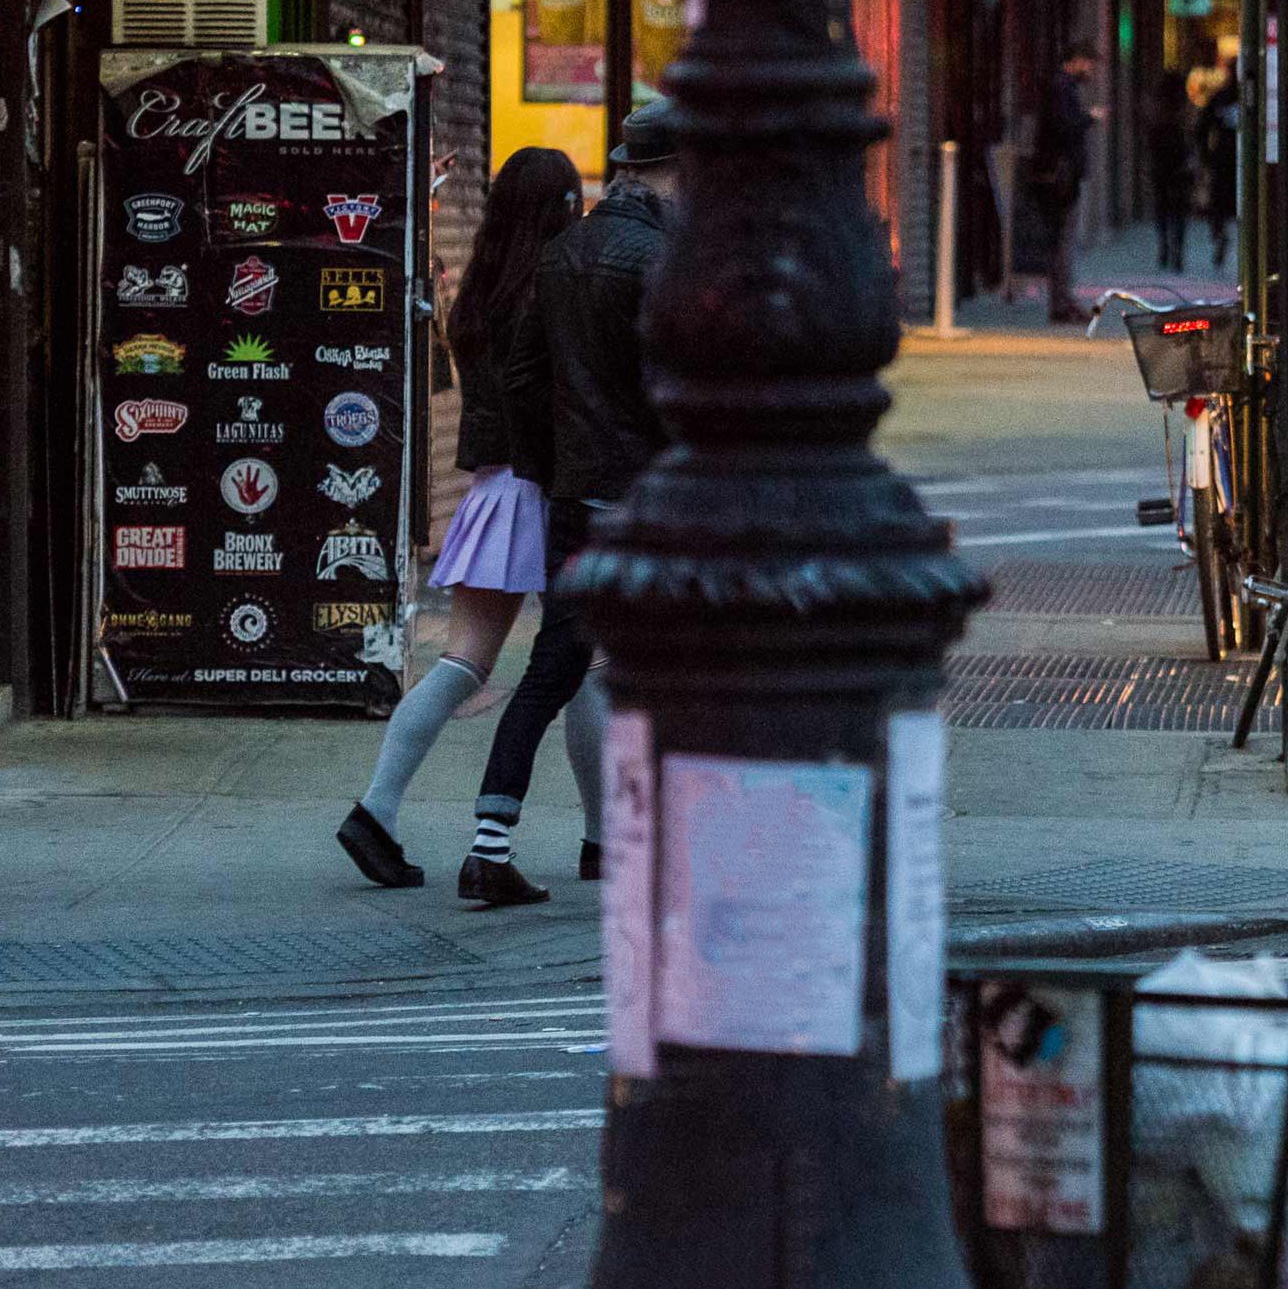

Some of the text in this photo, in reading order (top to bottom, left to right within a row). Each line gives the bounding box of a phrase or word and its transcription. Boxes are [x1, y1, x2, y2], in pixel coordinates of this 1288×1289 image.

[127, 83, 266, 175] Craft
[279, 147, 377, 156] SOLD HERE
[131, 199, 176, 210] GREENPORT
[230, 203, 276, 218] MAGIC
[234, 220, 270, 233] HAT
[208, 364, 290, 380] Green Flash
[216, 423, 285, 439] LAGUNITAS
[115, 486, 188, 504] SMUTTYNOSE
[115, 527, 176, 548] GREAT
[225, 531, 274, 552] BRONX
[116, 548, 176, 568] DIVIDE
[213, 549, 284, 571] BREWERY
[315, 603, 389, 630] ELYSIAN
[127, 668, 169, 682] Here
[194, 669, 247, 682] SUPER
[250, 669, 287, 682] DELI
[290, 669, 368, 682] GROCERY
